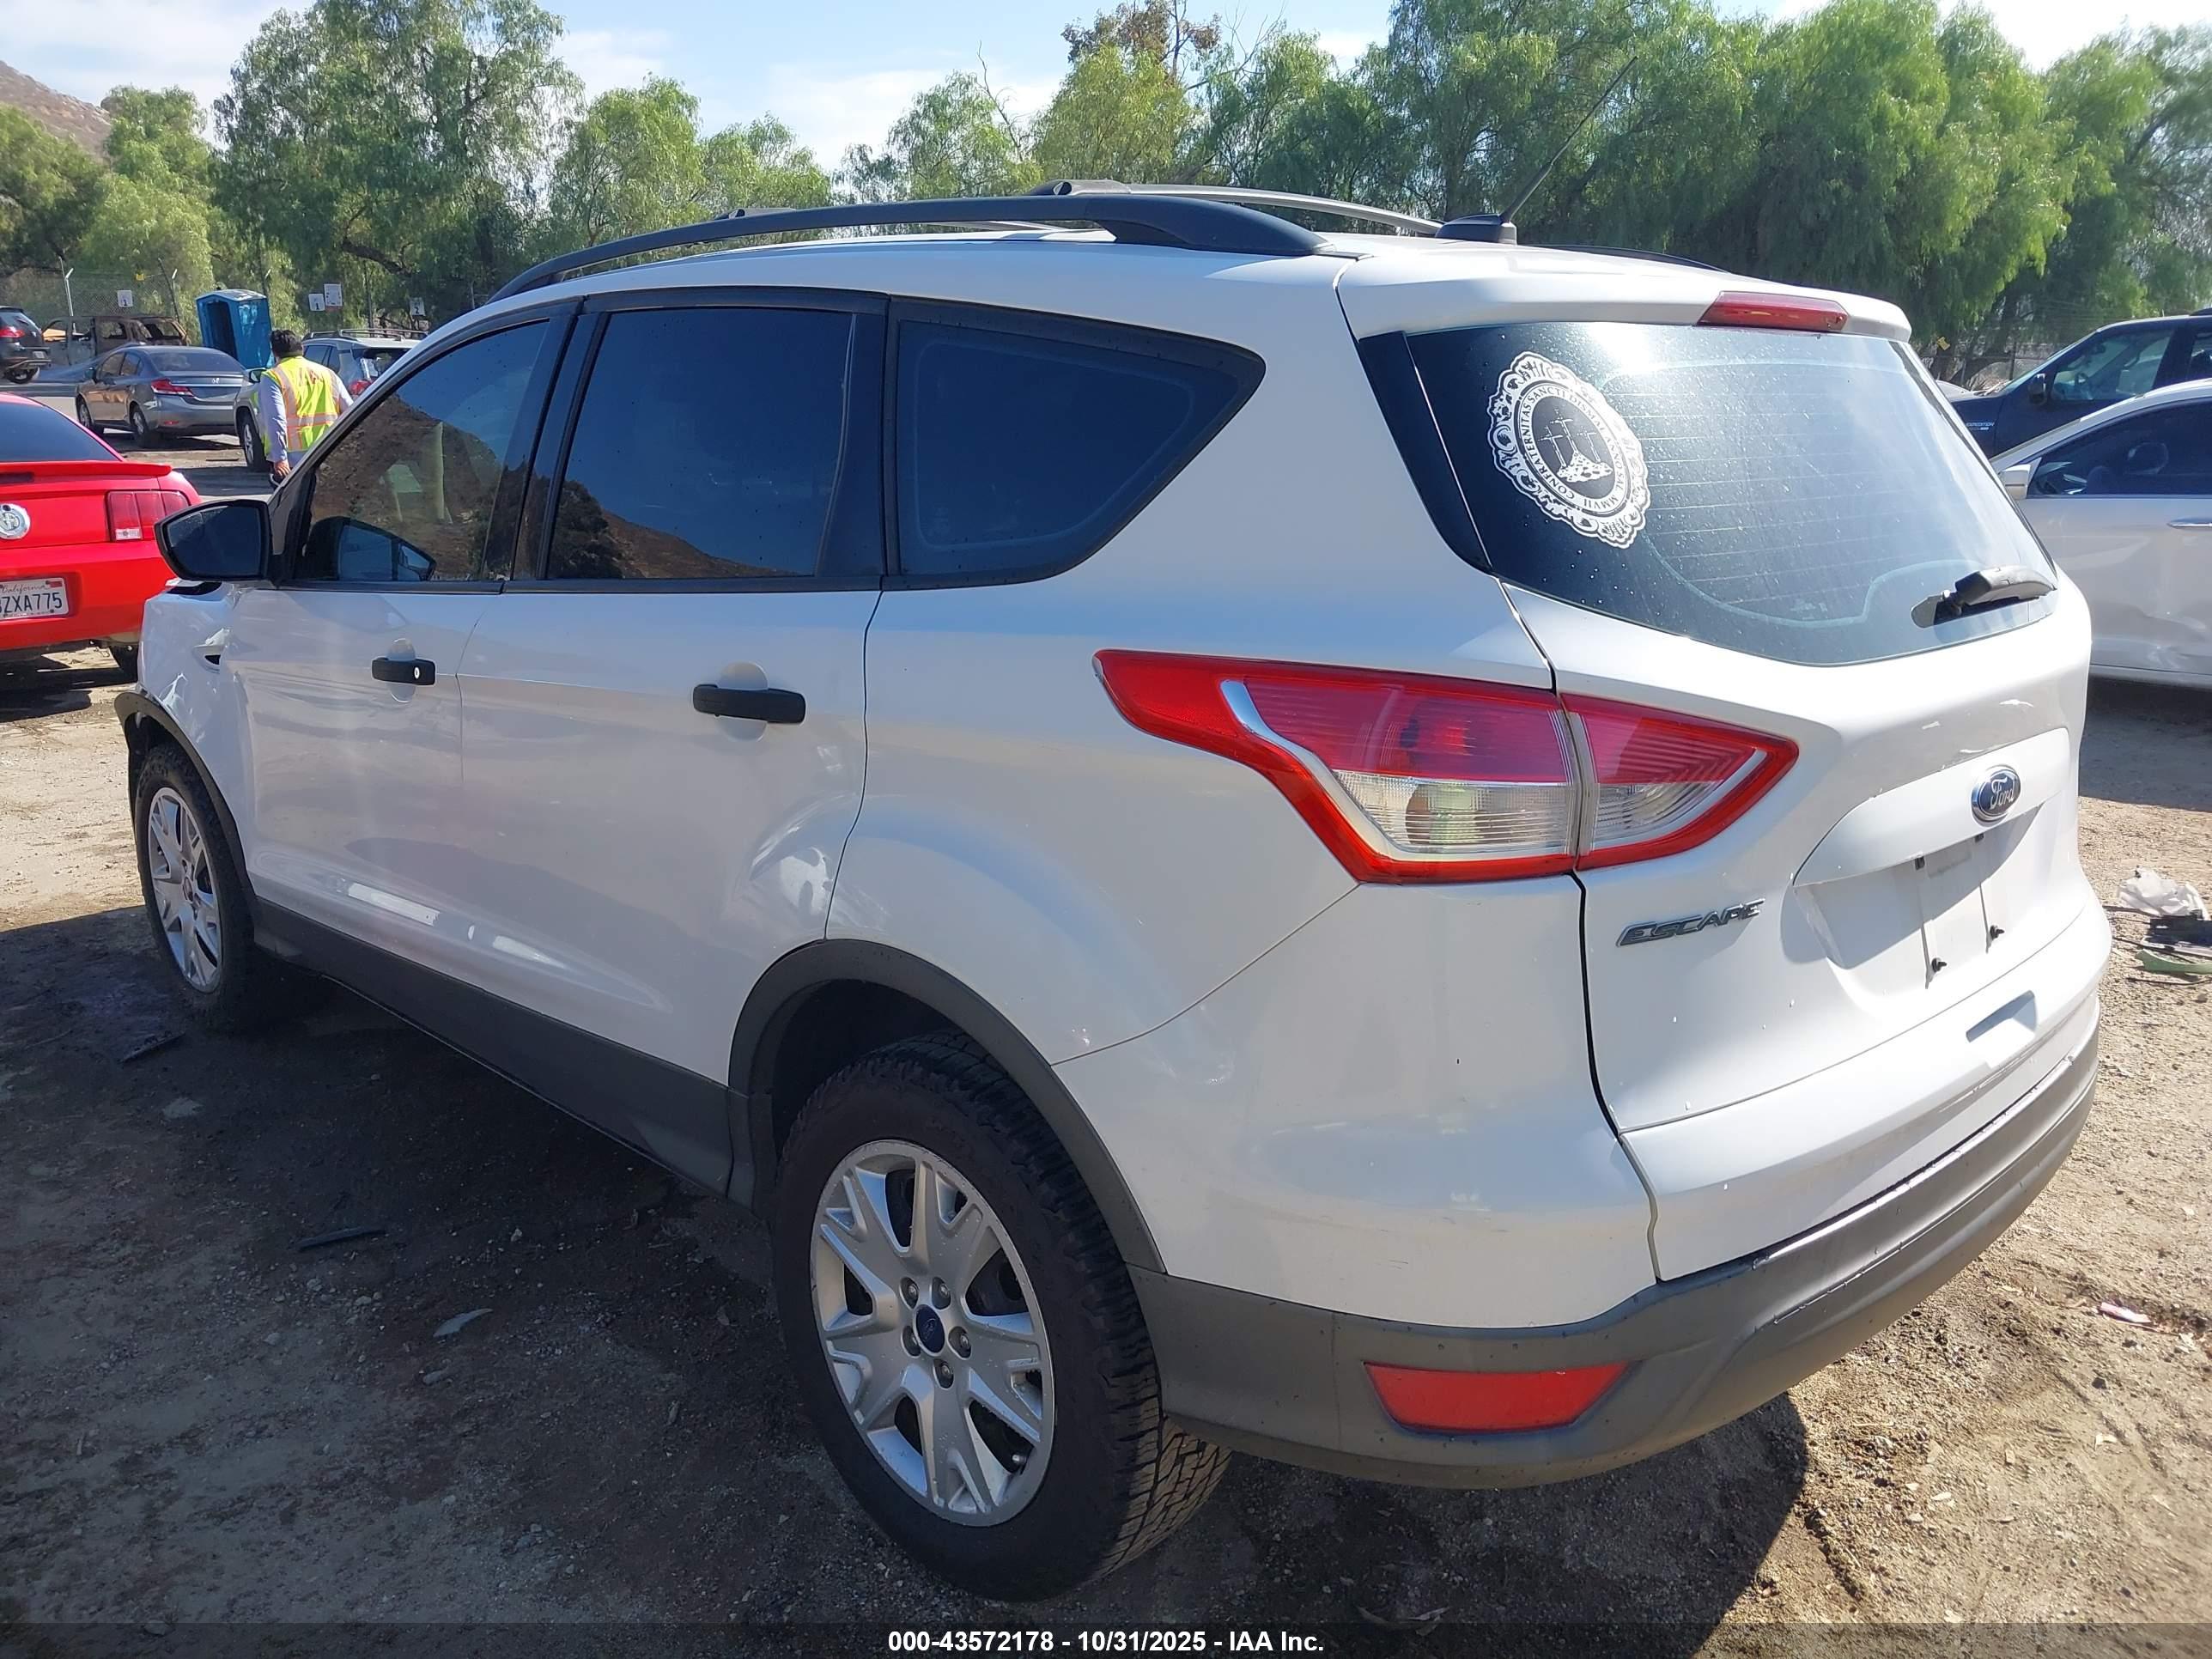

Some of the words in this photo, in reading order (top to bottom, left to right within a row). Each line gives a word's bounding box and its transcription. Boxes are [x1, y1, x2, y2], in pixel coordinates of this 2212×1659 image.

[1527, 386, 1566, 404] SANCTI
[1521, 402, 1576, 499] CONFRATERNITAS
[1990, 776, 2014, 810] Ford
[1615, 897, 1766, 947] ESCAPE
